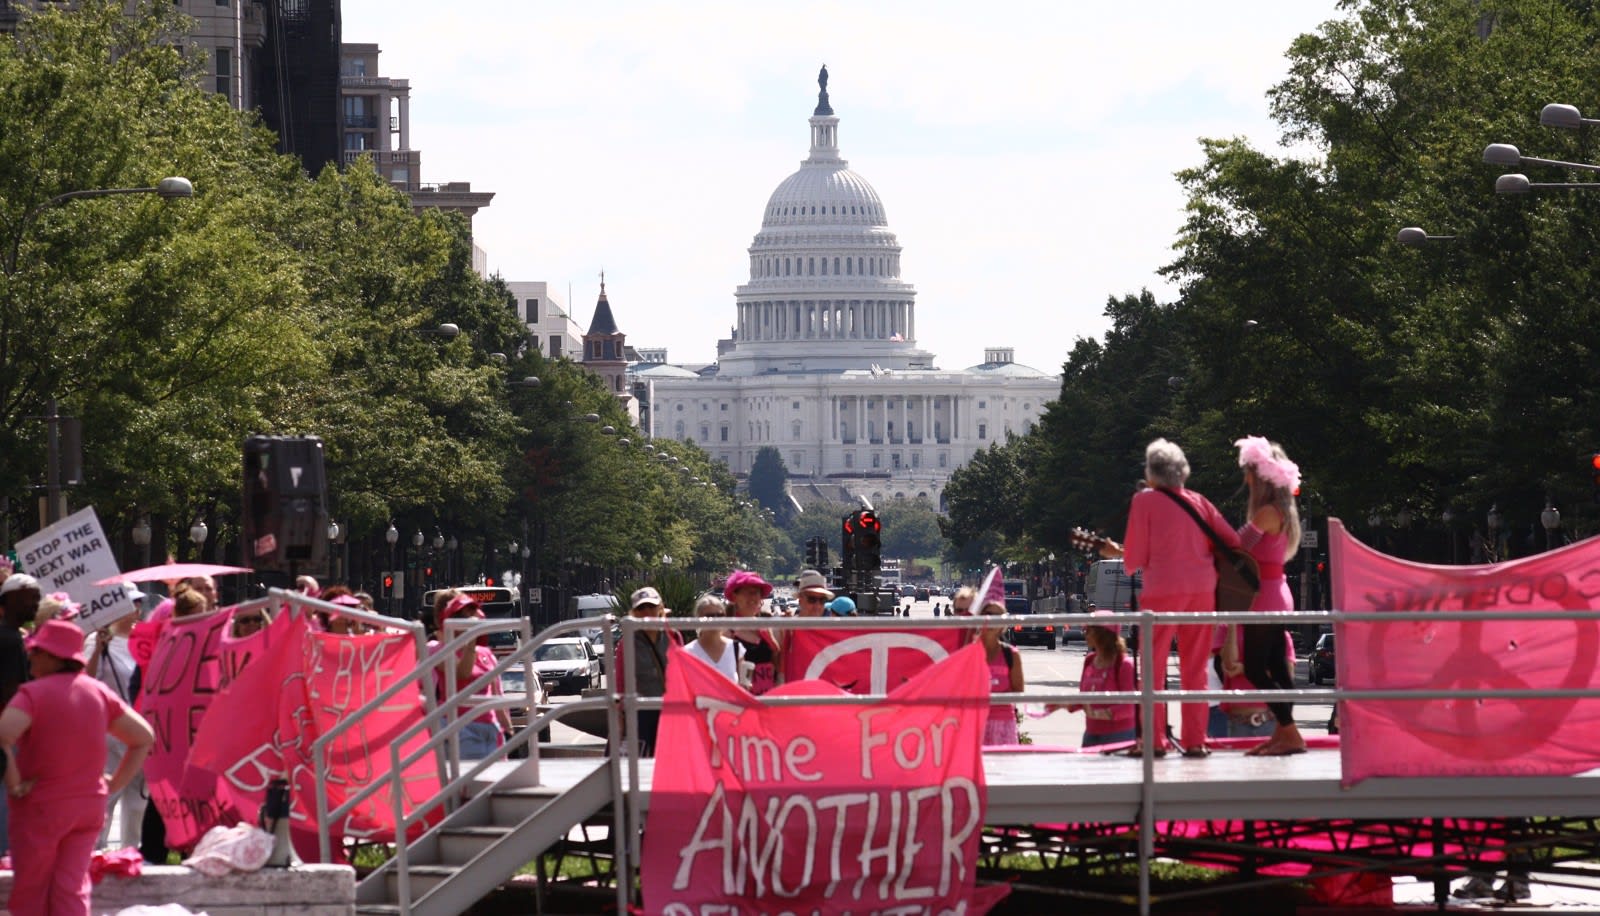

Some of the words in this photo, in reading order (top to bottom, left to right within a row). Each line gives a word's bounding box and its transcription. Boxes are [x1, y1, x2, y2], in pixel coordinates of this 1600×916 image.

[25, 538, 61, 565] STOP
[63, 522, 94, 544] THE
[29, 554, 65, 579] NEXT
[67, 537, 102, 561] WAR
[74, 586, 126, 619] EACH
[695, 695, 823, 782] Time
[856, 707, 960, 780] For
[671, 776, 980, 899] ANOTHER
